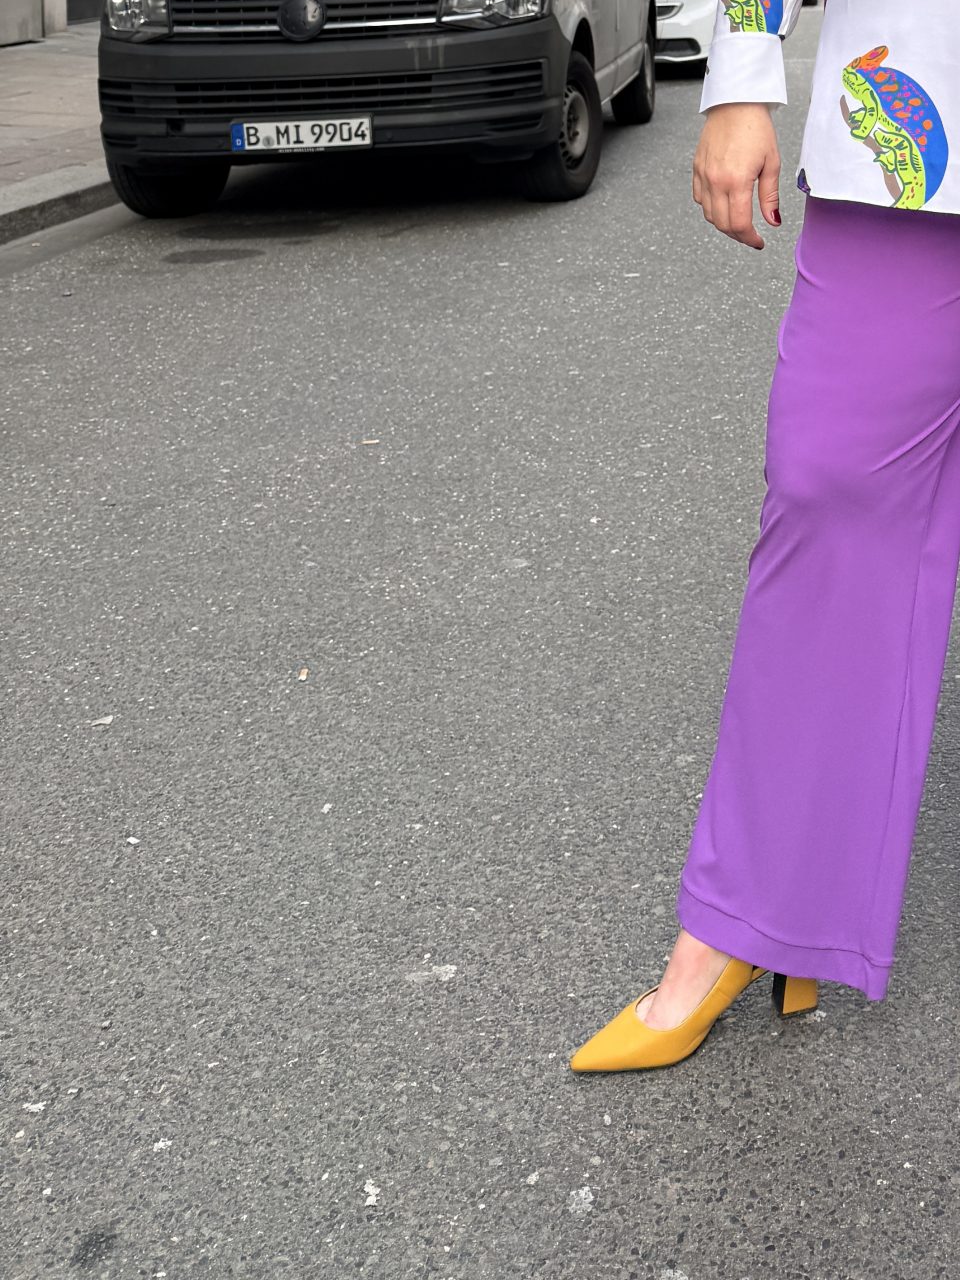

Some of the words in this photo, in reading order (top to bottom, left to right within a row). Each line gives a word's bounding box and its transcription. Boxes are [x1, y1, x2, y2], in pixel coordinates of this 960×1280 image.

[245, 126, 260, 146] B
[275, 124, 304, 145] MI
[310, 121, 368, 144] 9904
